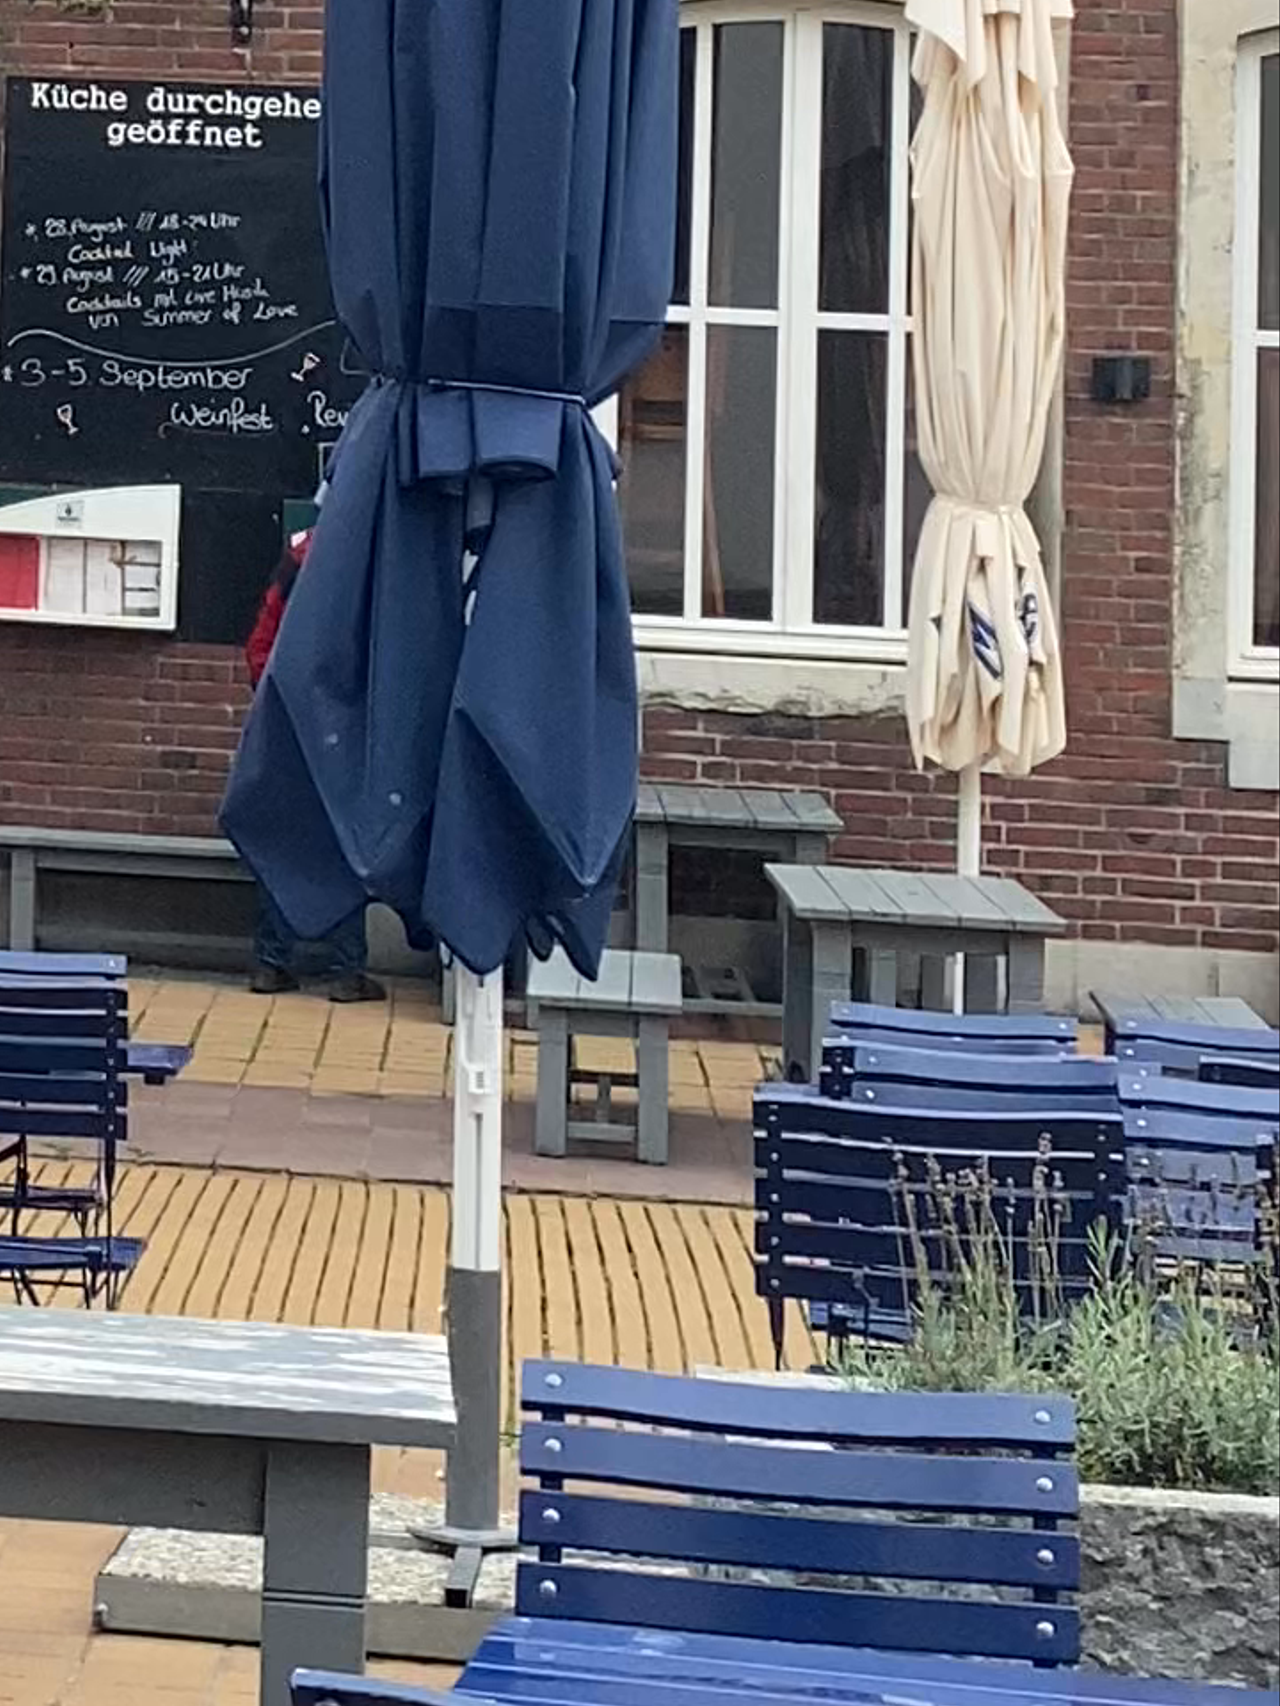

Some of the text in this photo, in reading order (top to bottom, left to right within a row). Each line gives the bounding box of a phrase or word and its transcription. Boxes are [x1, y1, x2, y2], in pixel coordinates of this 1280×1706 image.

[31, 82, 323, 119] Küche durchgehe
[107, 119, 262, 147] geöffnet
[252, 302, 299, 320] Love
[98, 361, 253, 391] September
[170, 397, 274, 431] Weinfest
